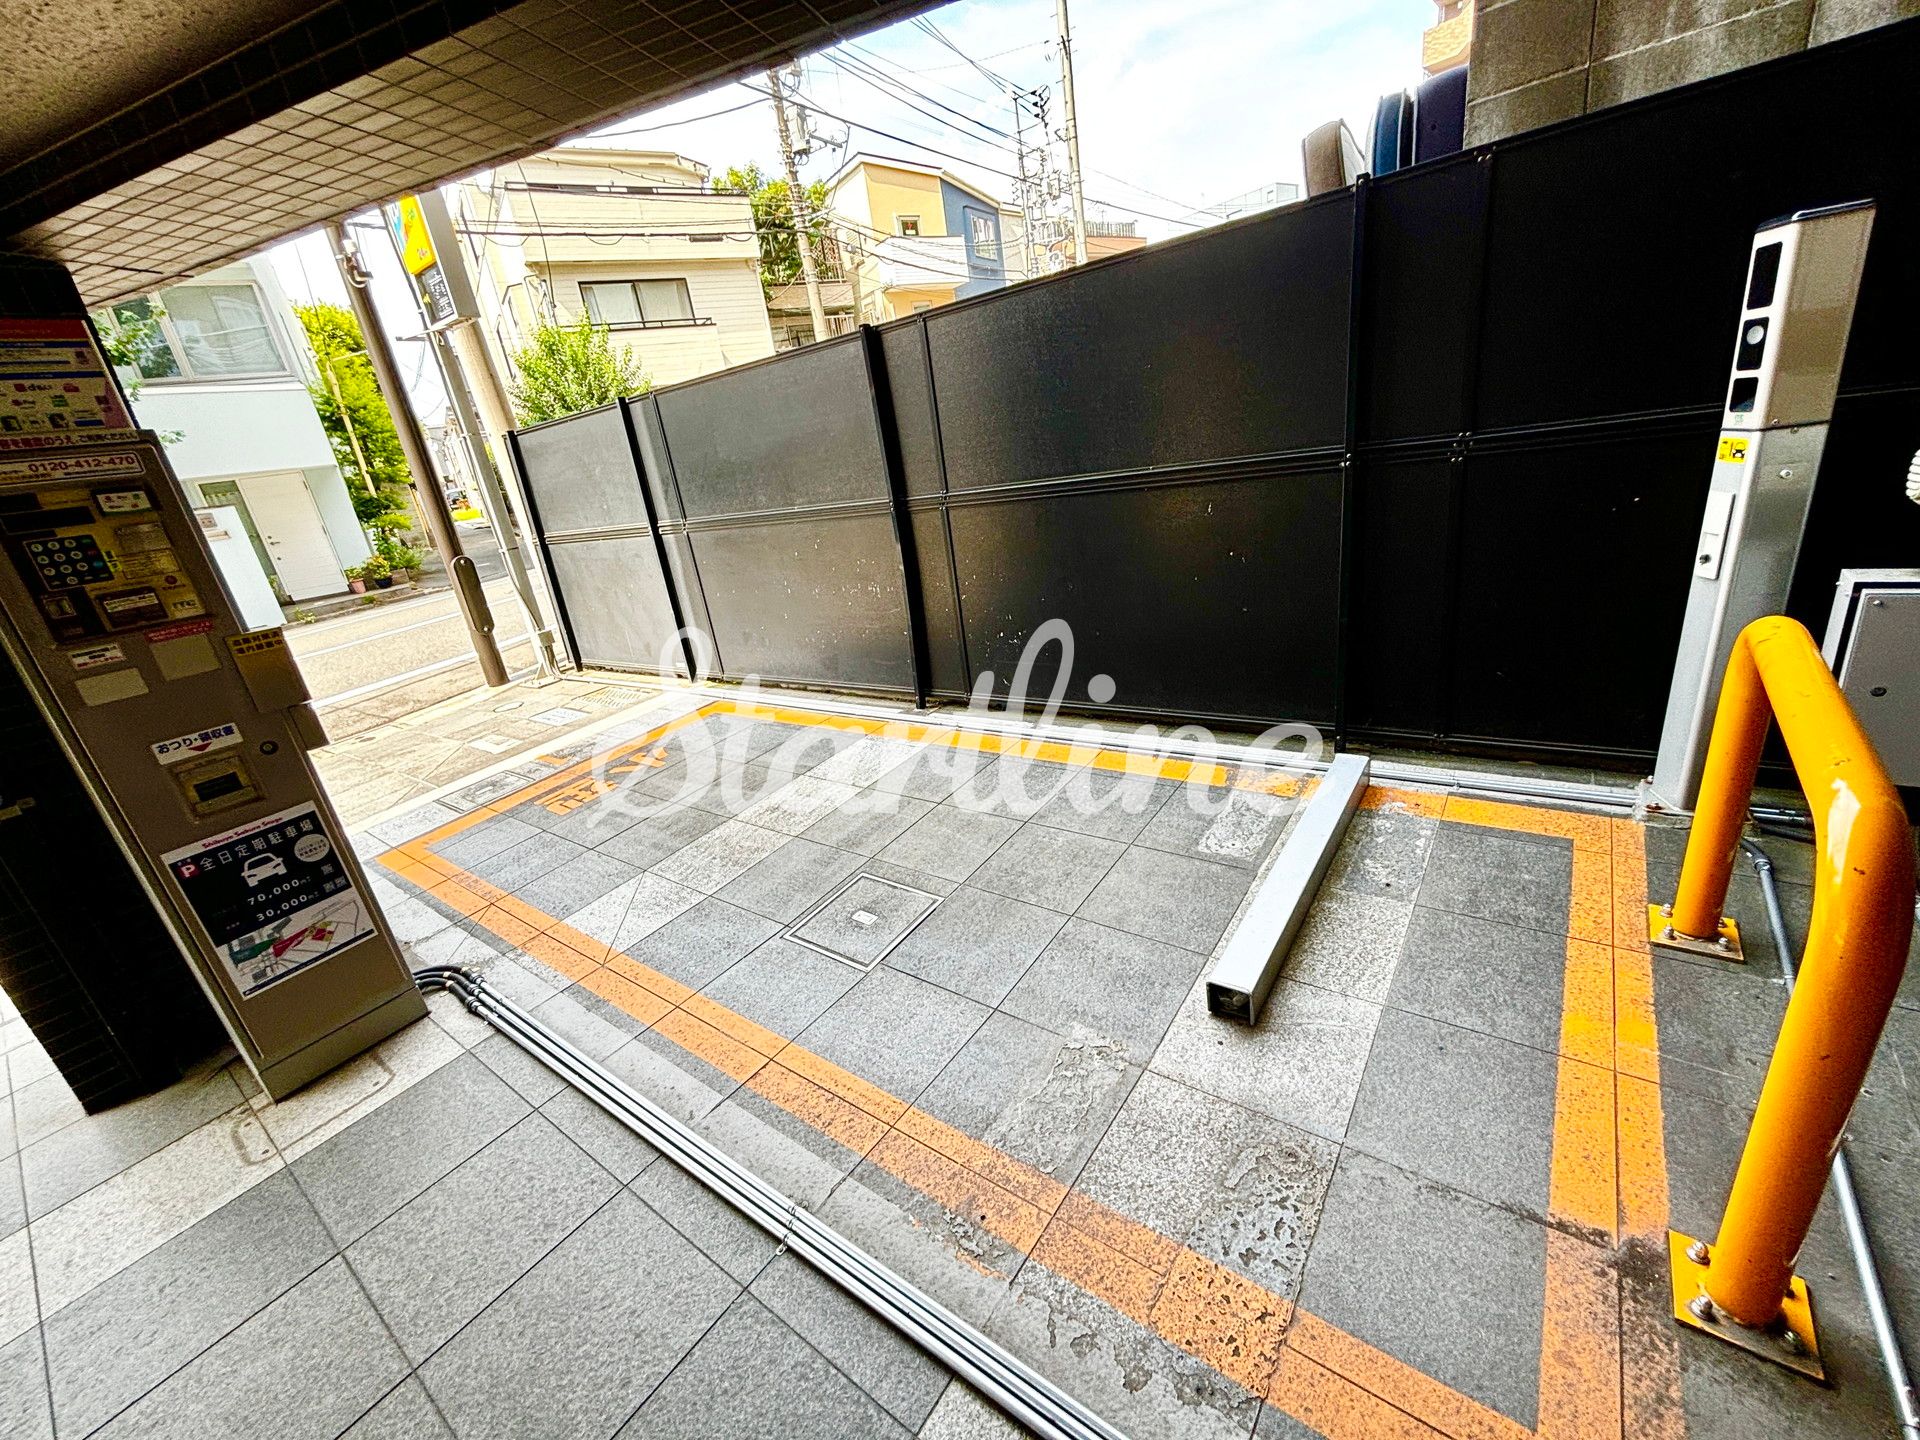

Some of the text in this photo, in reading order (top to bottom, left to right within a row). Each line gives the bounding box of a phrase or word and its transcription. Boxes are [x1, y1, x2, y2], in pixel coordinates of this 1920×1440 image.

[28, 455, 136, 473] 0120-412-470
[156, 725, 235, 755] おつり・領収書
[200, 819, 314, 872] 全日定期駐車場
